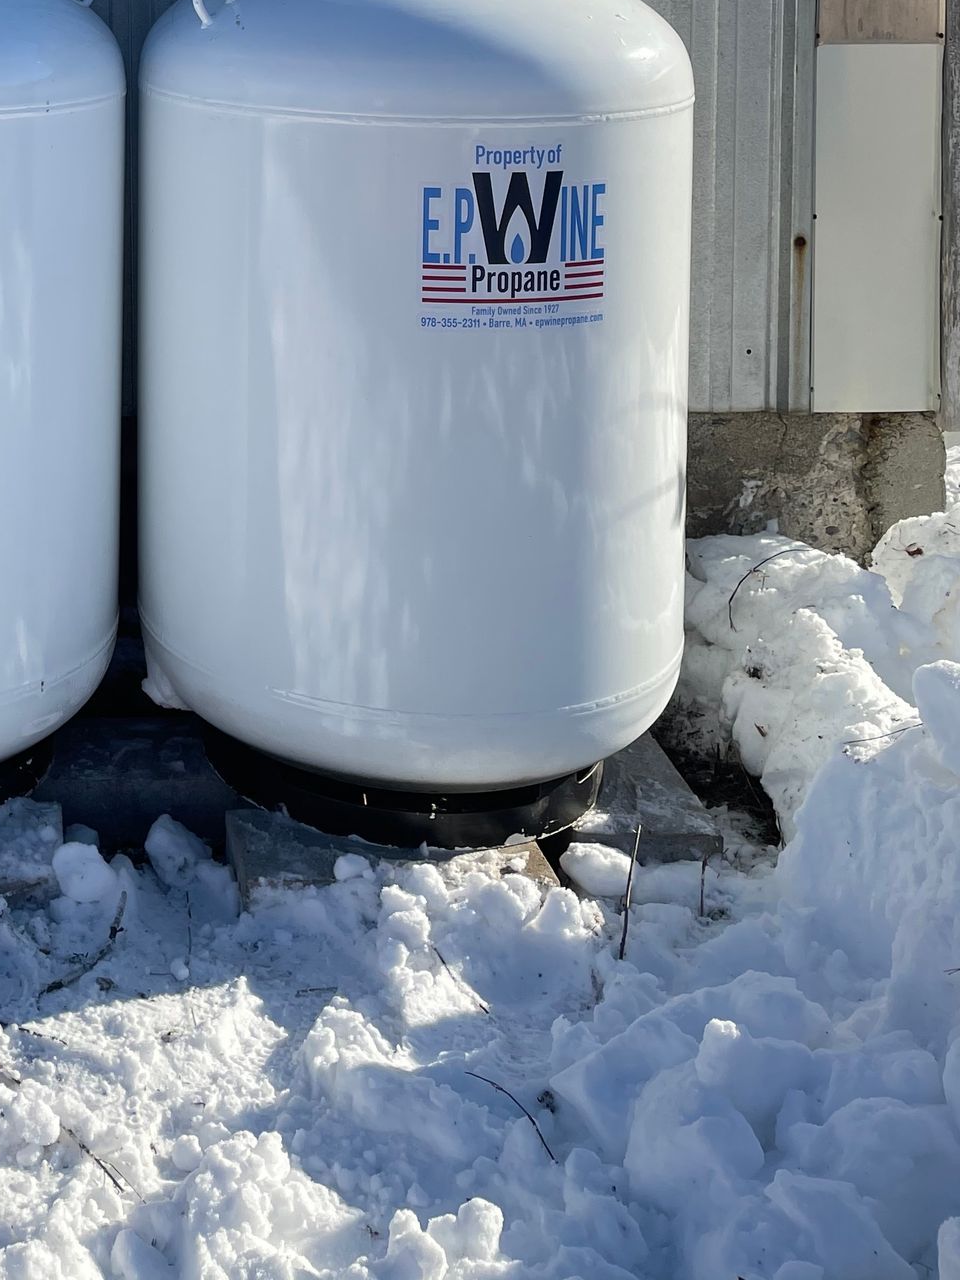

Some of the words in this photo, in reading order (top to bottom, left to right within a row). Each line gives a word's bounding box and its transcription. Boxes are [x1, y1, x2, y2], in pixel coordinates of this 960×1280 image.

[475, 145, 545, 170] Property
[547, 144, 562, 163] of
[422, 187, 476, 264] E.P.
[472, 170, 606, 265] WINE
[471, 265, 561, 298] Propane
[421, 317, 481, 328] 978-355-2311
[489, 318, 513, 329] Barre,
[515, 317, 527, 327] MA
[535, 313, 603, 327] epwinepropane.com
[471, 306, 495, 317] Family
[497, 306, 521, 315] Owned
[523, 305, 542, 314] Since
[544, 304, 559, 314] 1927
